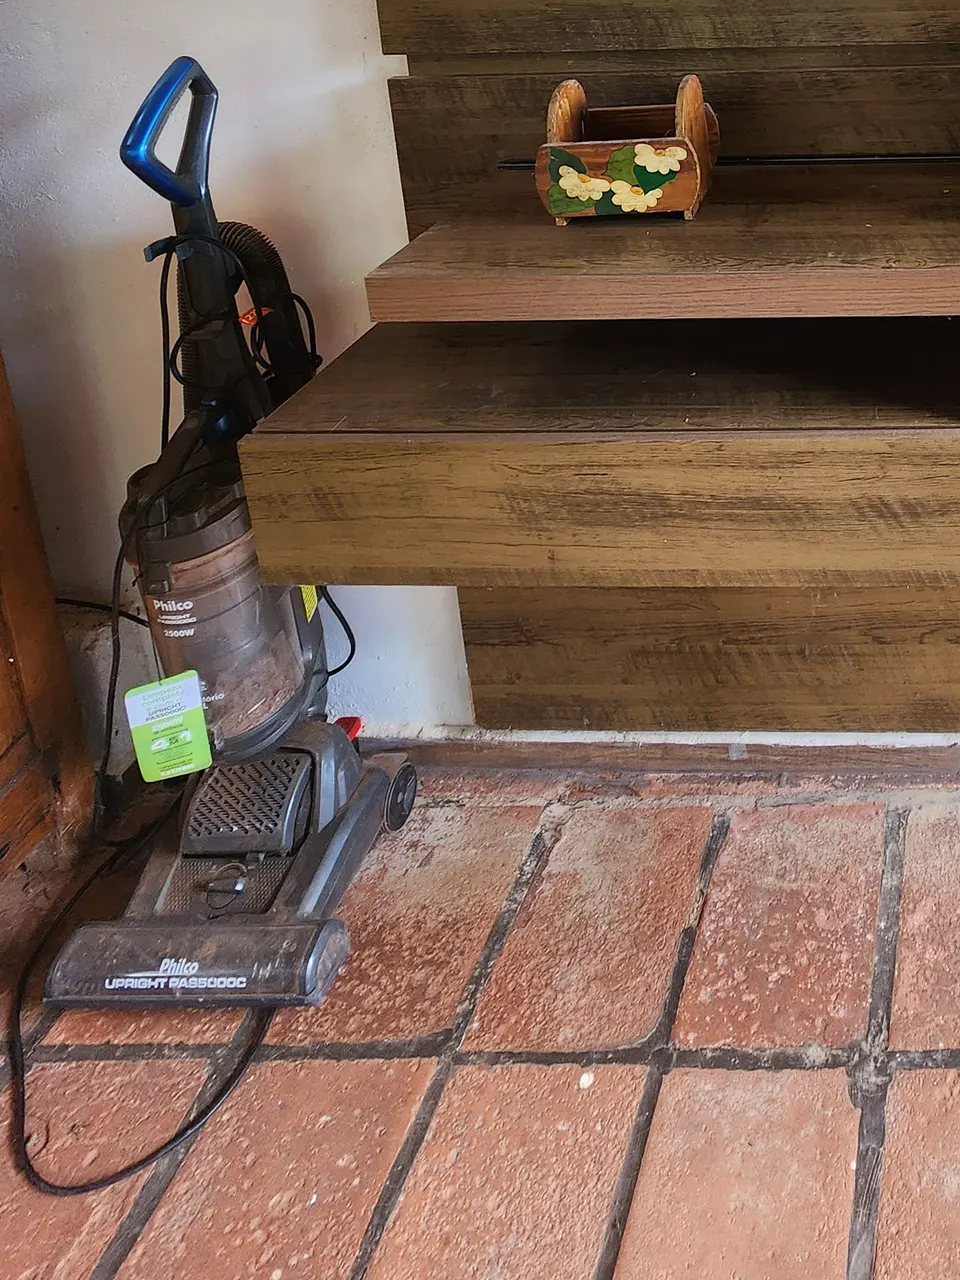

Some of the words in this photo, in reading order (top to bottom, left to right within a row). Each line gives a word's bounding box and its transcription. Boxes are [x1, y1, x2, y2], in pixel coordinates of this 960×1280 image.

[153, 599, 194, 612] Philco
[163, 628, 195, 638] 2500W
[159, 957, 200, 975] Philco
[104, 977, 168, 990] UPRIGHT
